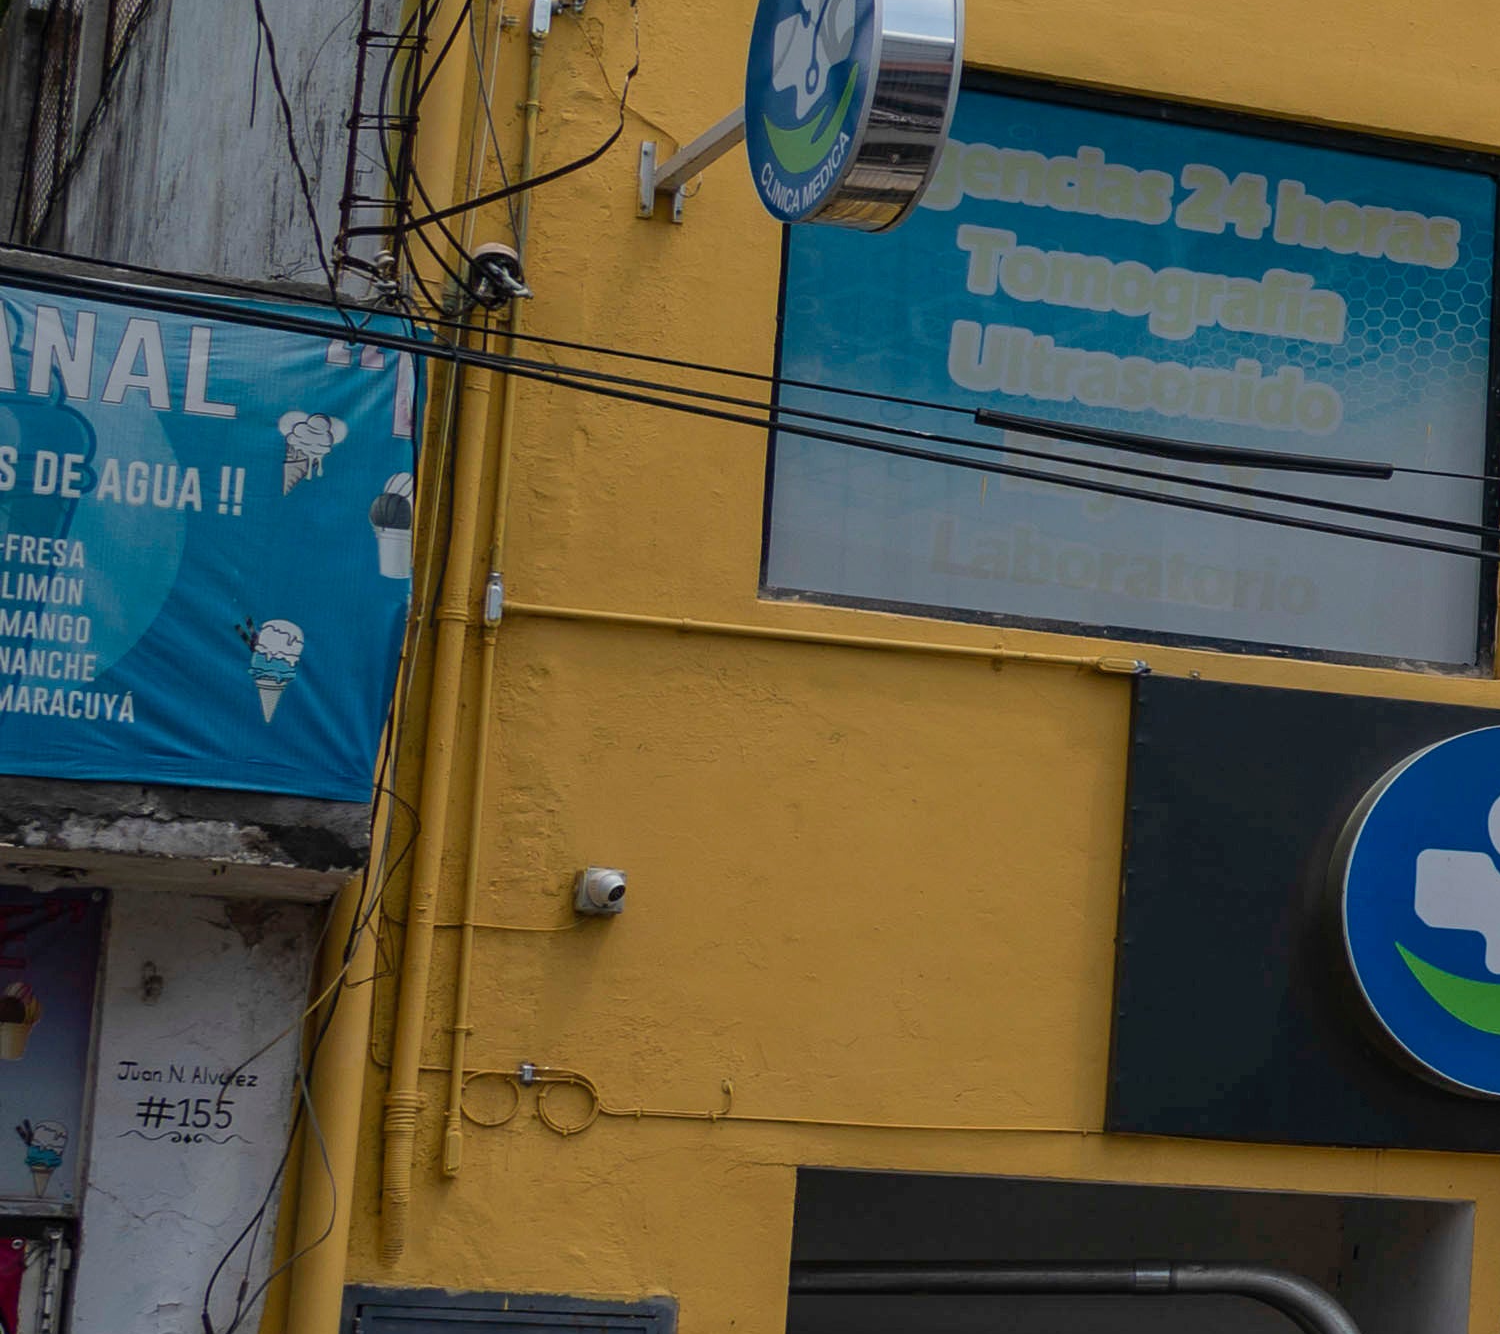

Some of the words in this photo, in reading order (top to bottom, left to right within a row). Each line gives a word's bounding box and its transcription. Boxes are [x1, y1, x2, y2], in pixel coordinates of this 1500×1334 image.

[759, 161, 801, 214] CLINICA
[801, 130, 851, 211] MEDICA
[1176, 163, 1272, 239] 24
[1273, 178, 1461, 269] horas
[0, 298, 238, 419] NAL
[947, 319, 1344, 435] Ultrasonido
[33, 449, 86, 499] DE
[97, 457, 202, 512] AGUA
[1, 571, 84, 606] LIMÓN
[0, 608, 91, 644] MANGO
[0, 646, 98, 682] NANCHE
[0, 683, 136, 724] MARACUYÁ
[117, 1060, 163, 1082] Juan
[135, 1095, 236, 1130] #155
